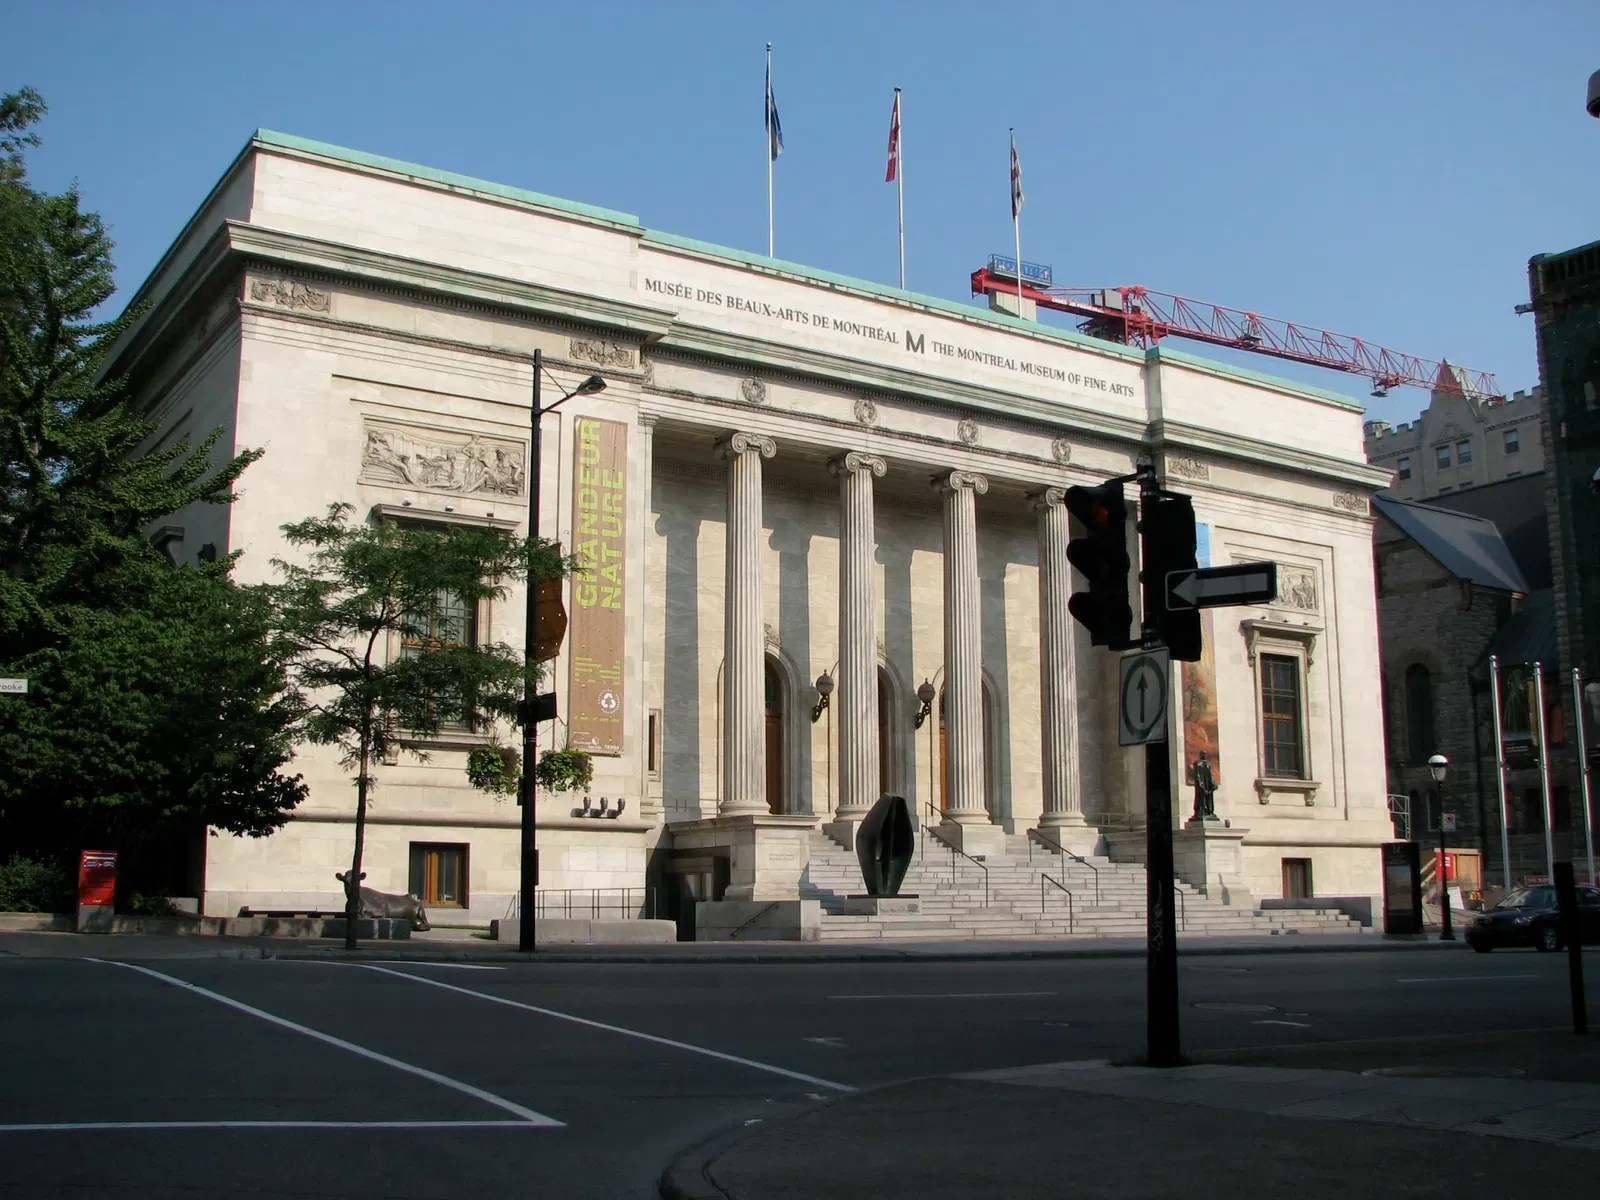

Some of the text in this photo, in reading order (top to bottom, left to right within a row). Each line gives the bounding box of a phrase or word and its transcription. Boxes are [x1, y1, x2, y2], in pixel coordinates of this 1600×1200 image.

[645, 278, 1134, 397] MUSÉE DES BEAUX-ARTS DE MONTRÉAL M THE MONTREAL MUSEUM OF FINE ARTS
[576, 420, 602, 608] GRANDEUR
[601, 468, 624, 610] NATURE
